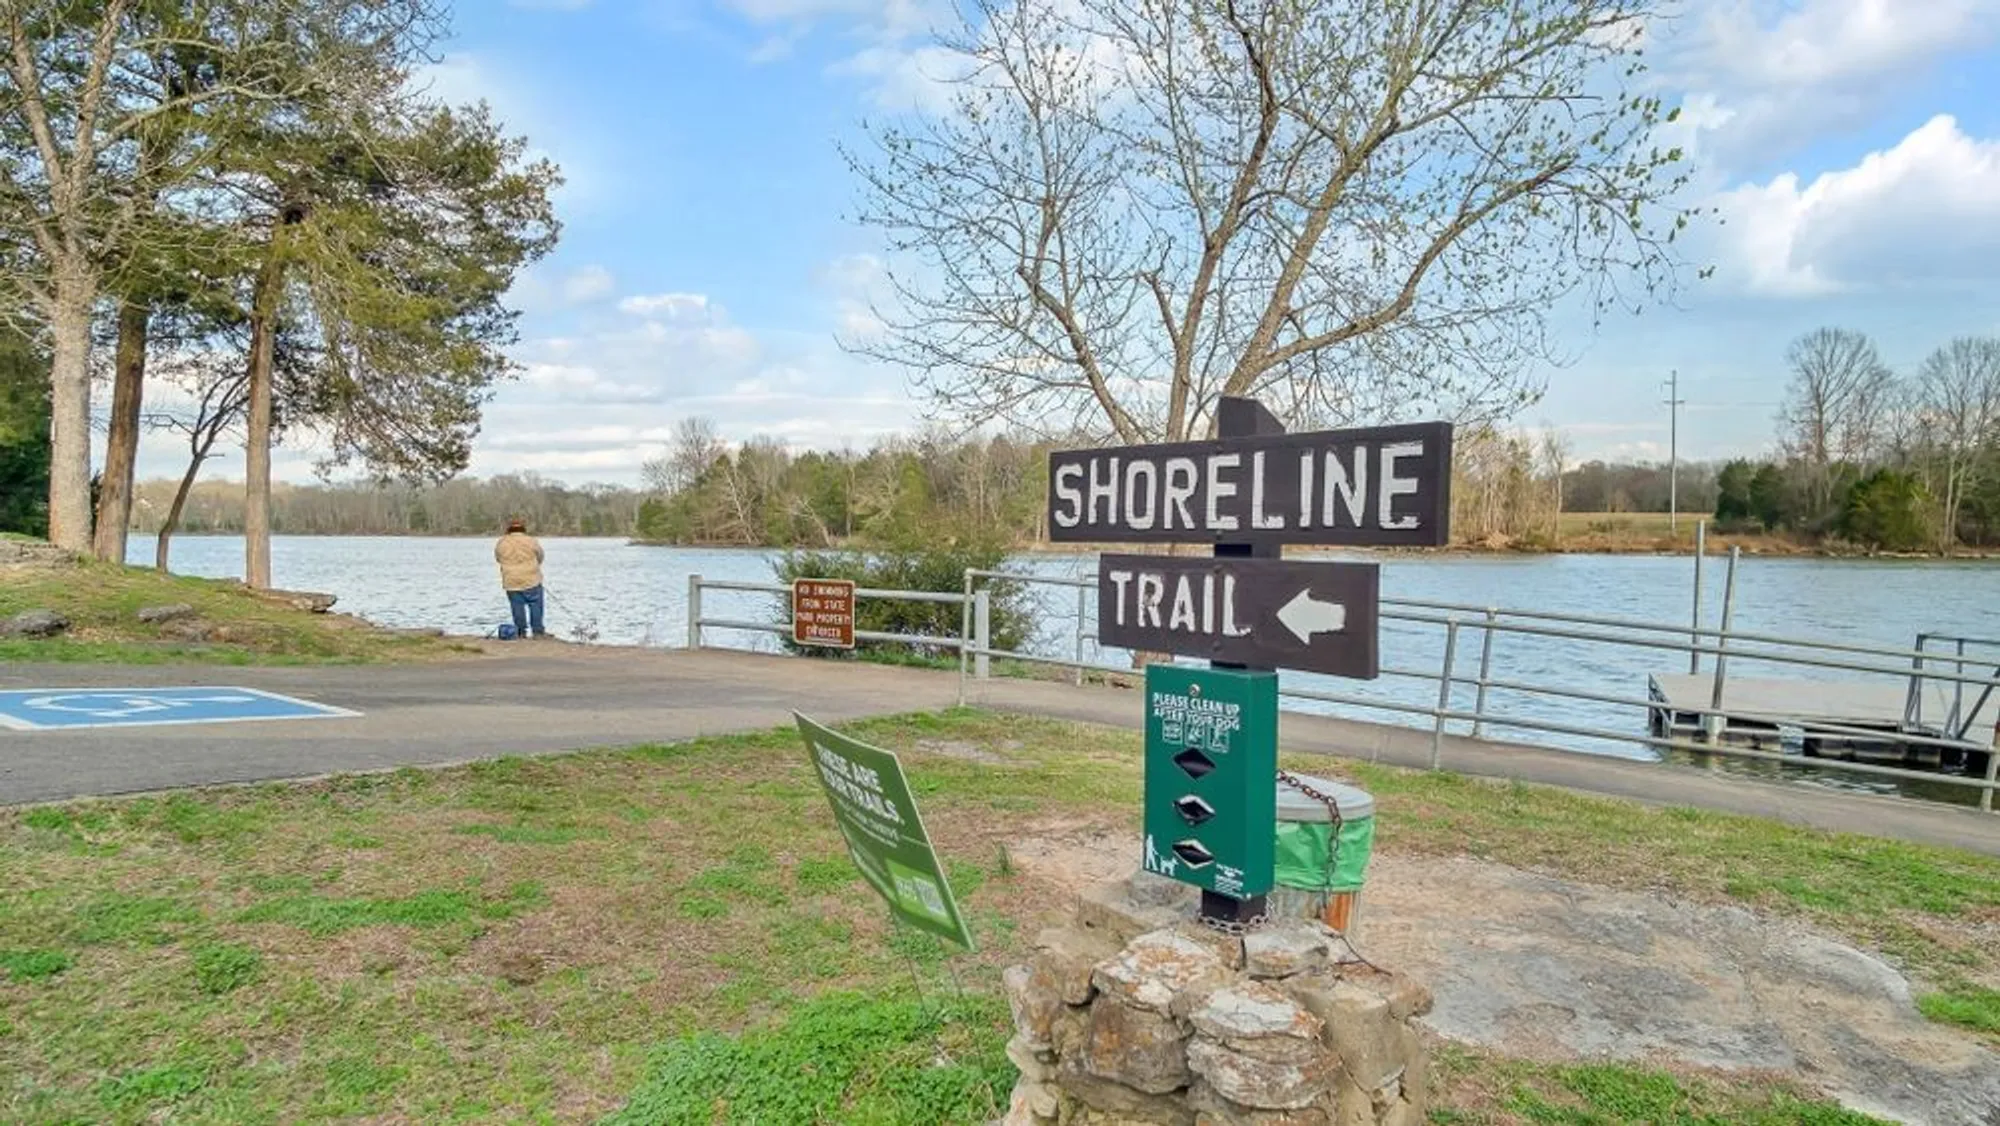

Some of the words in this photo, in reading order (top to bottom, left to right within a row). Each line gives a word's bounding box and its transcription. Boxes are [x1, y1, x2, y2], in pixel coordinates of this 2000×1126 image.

[1054, 441, 1424, 531] SHORELINE
[1109, 569, 1253, 637] TRAIL
[1152, 706, 1184, 722] AFTER
[1186, 710, 1214, 726] YOUR
[1215, 716, 1240, 732] DOG
[1153, 692, 1189, 710] PLEASE
[1190, 698, 1224, 714] CLEAN
[1225, 703, 1240, 717] UP
